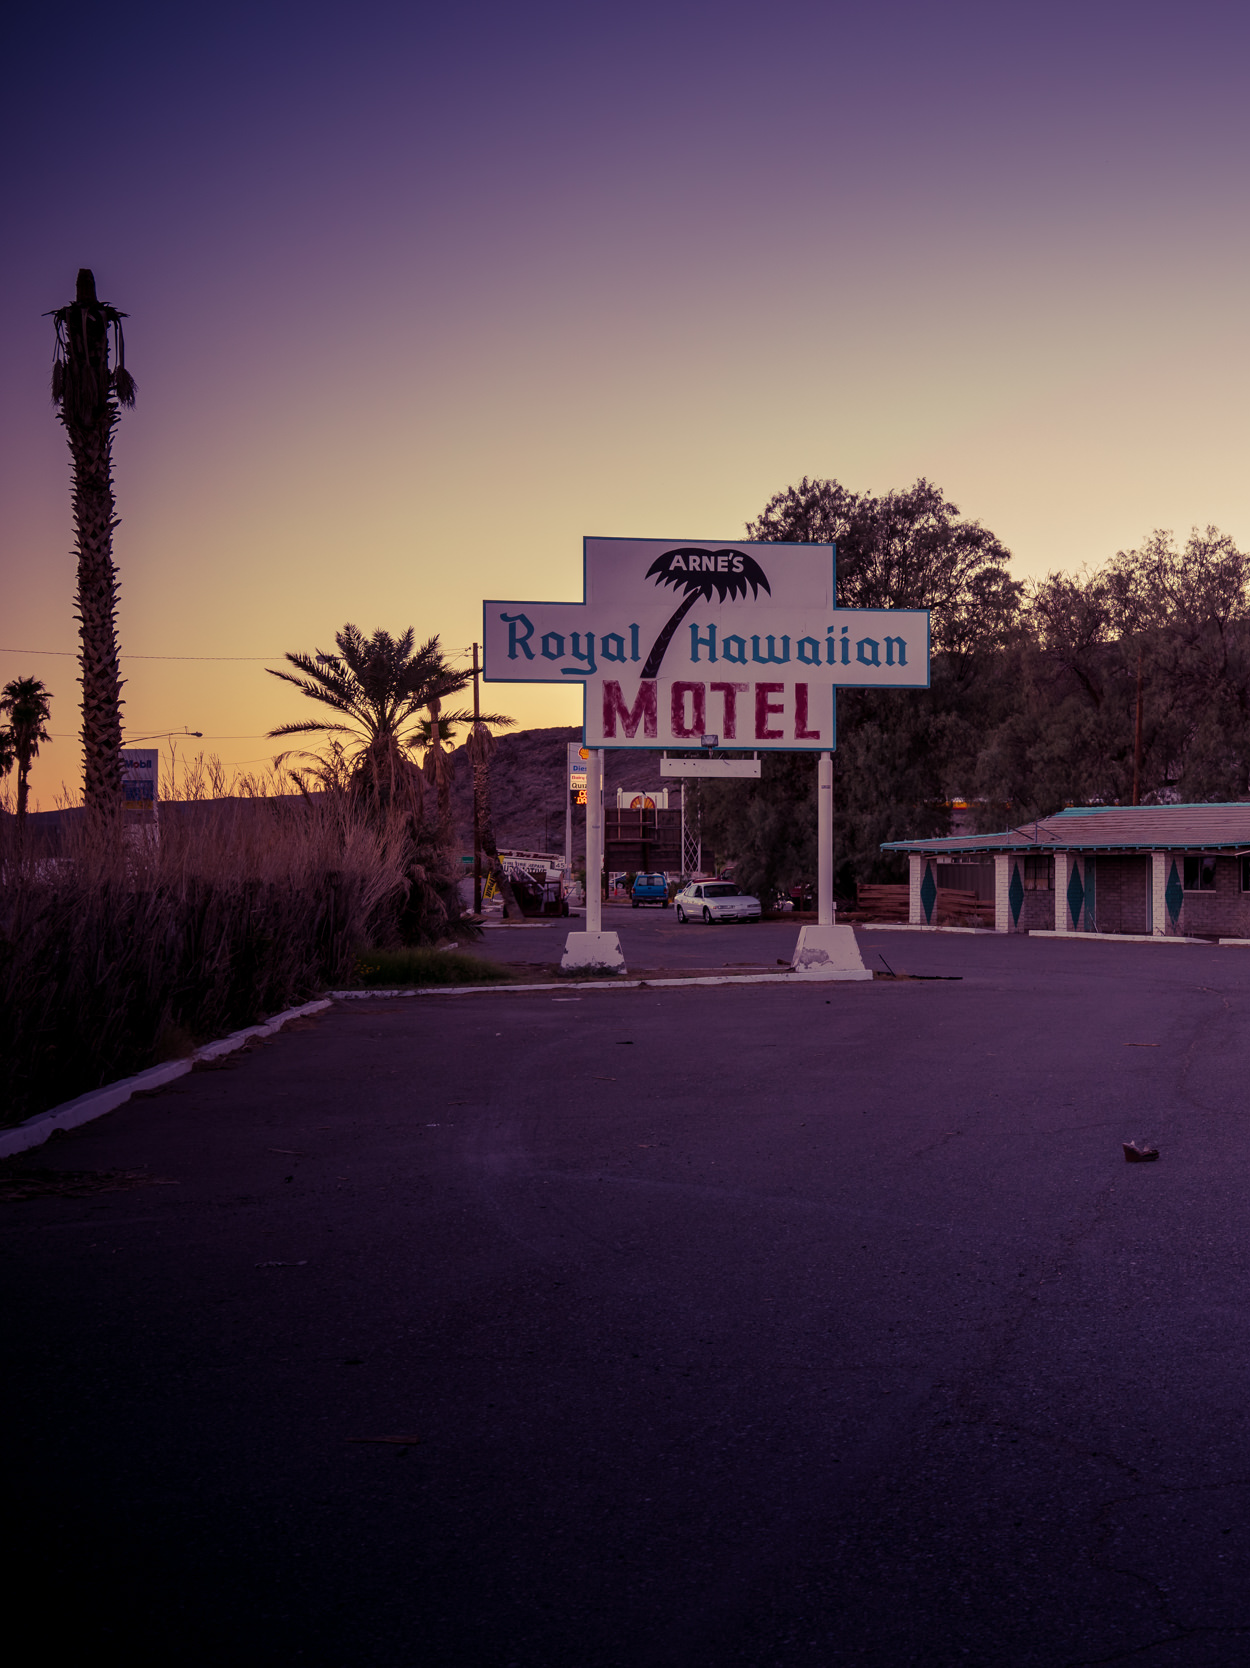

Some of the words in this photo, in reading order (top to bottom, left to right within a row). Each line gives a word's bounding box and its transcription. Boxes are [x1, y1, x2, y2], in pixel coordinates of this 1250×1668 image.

[668, 553, 745, 573] ARNE'S
[500, 612, 641, 675] Royal
[688, 622, 908, 668] Hawaiian
[602, 679, 821, 741] MOTEL
[125, 760, 152, 768] Mobil
